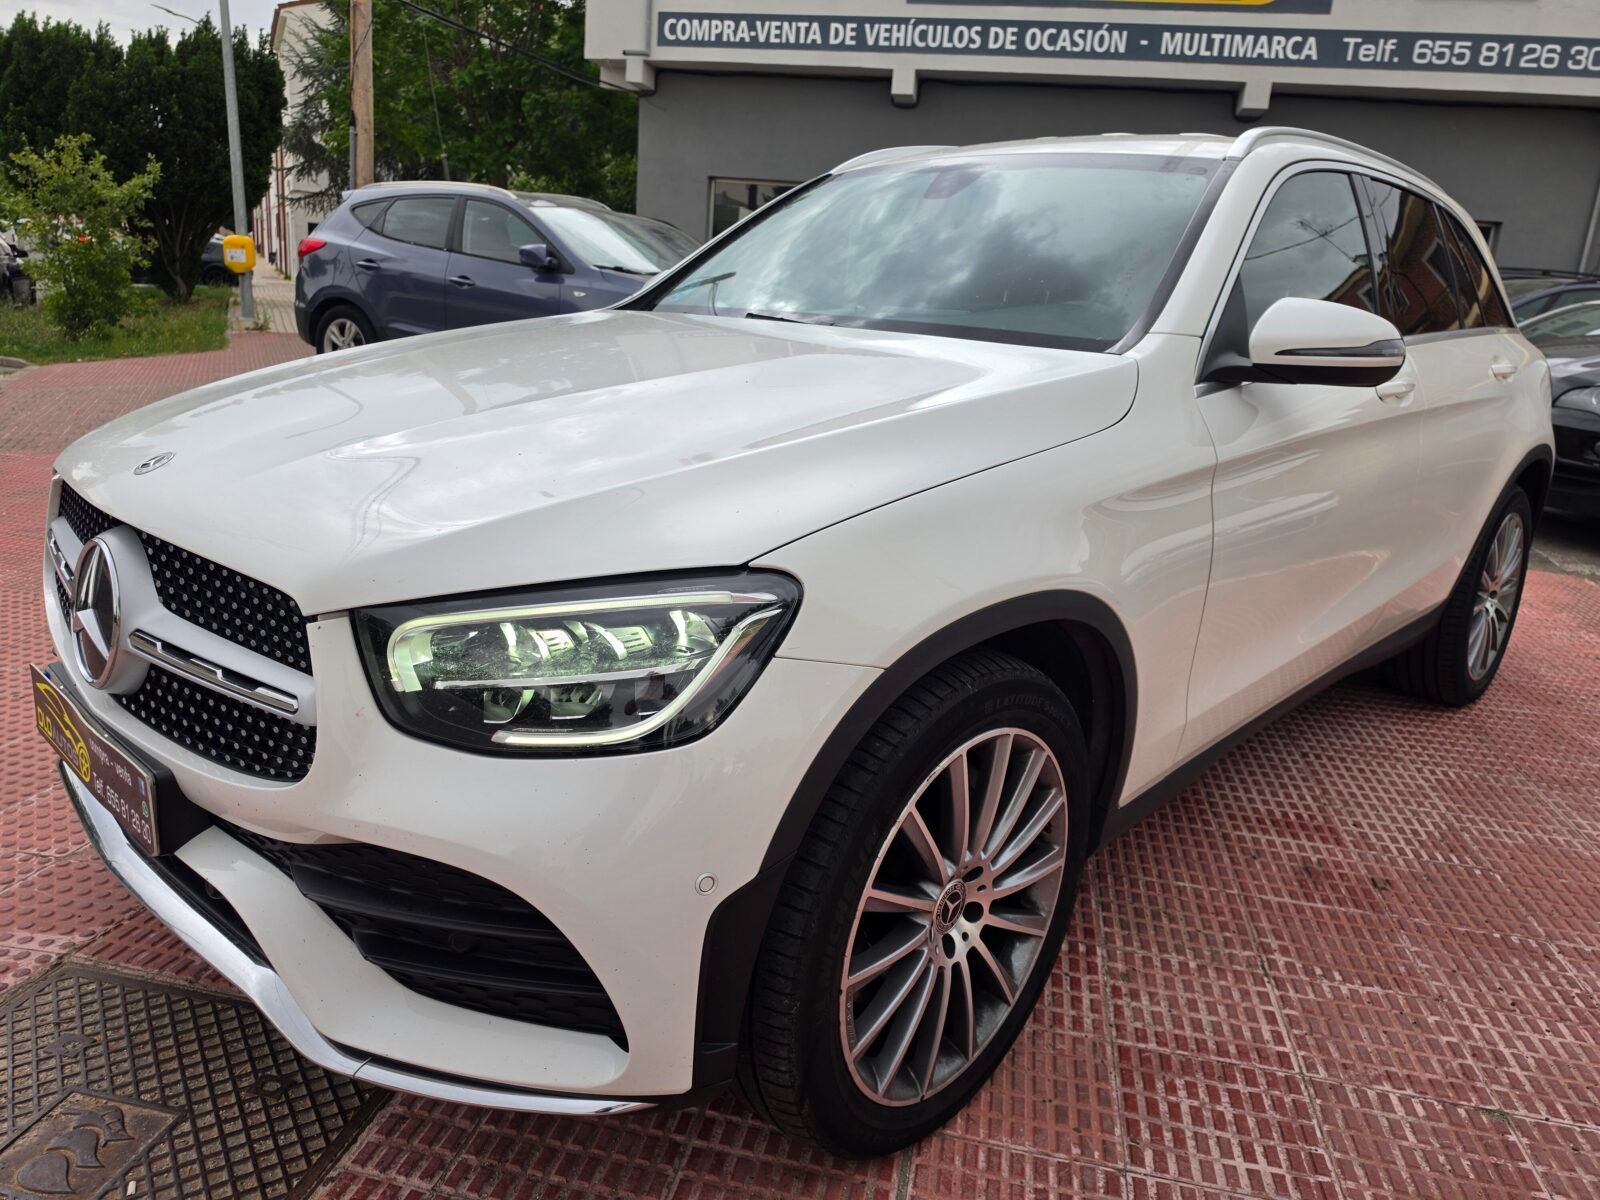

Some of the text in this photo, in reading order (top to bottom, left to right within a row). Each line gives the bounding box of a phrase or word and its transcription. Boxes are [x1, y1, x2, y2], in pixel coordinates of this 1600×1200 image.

[663, 18, 822, 45] COMPRA-VENTA
[828, 22, 857, 45] DE
[864, 18, 982, 49] VEHÍCULOS
[987, 26, 1019, 50] DE
[1024, 23, 1128, 53] OCASIÓN
[1160, 31, 1318, 61] MULTIMARCA
[1343, 37, 1399, 63] Telf.
[1411, 39, 1472, 66] 655
[1478, 42, 1515, 67] 81
[1518, 43, 1561, 69] 26
